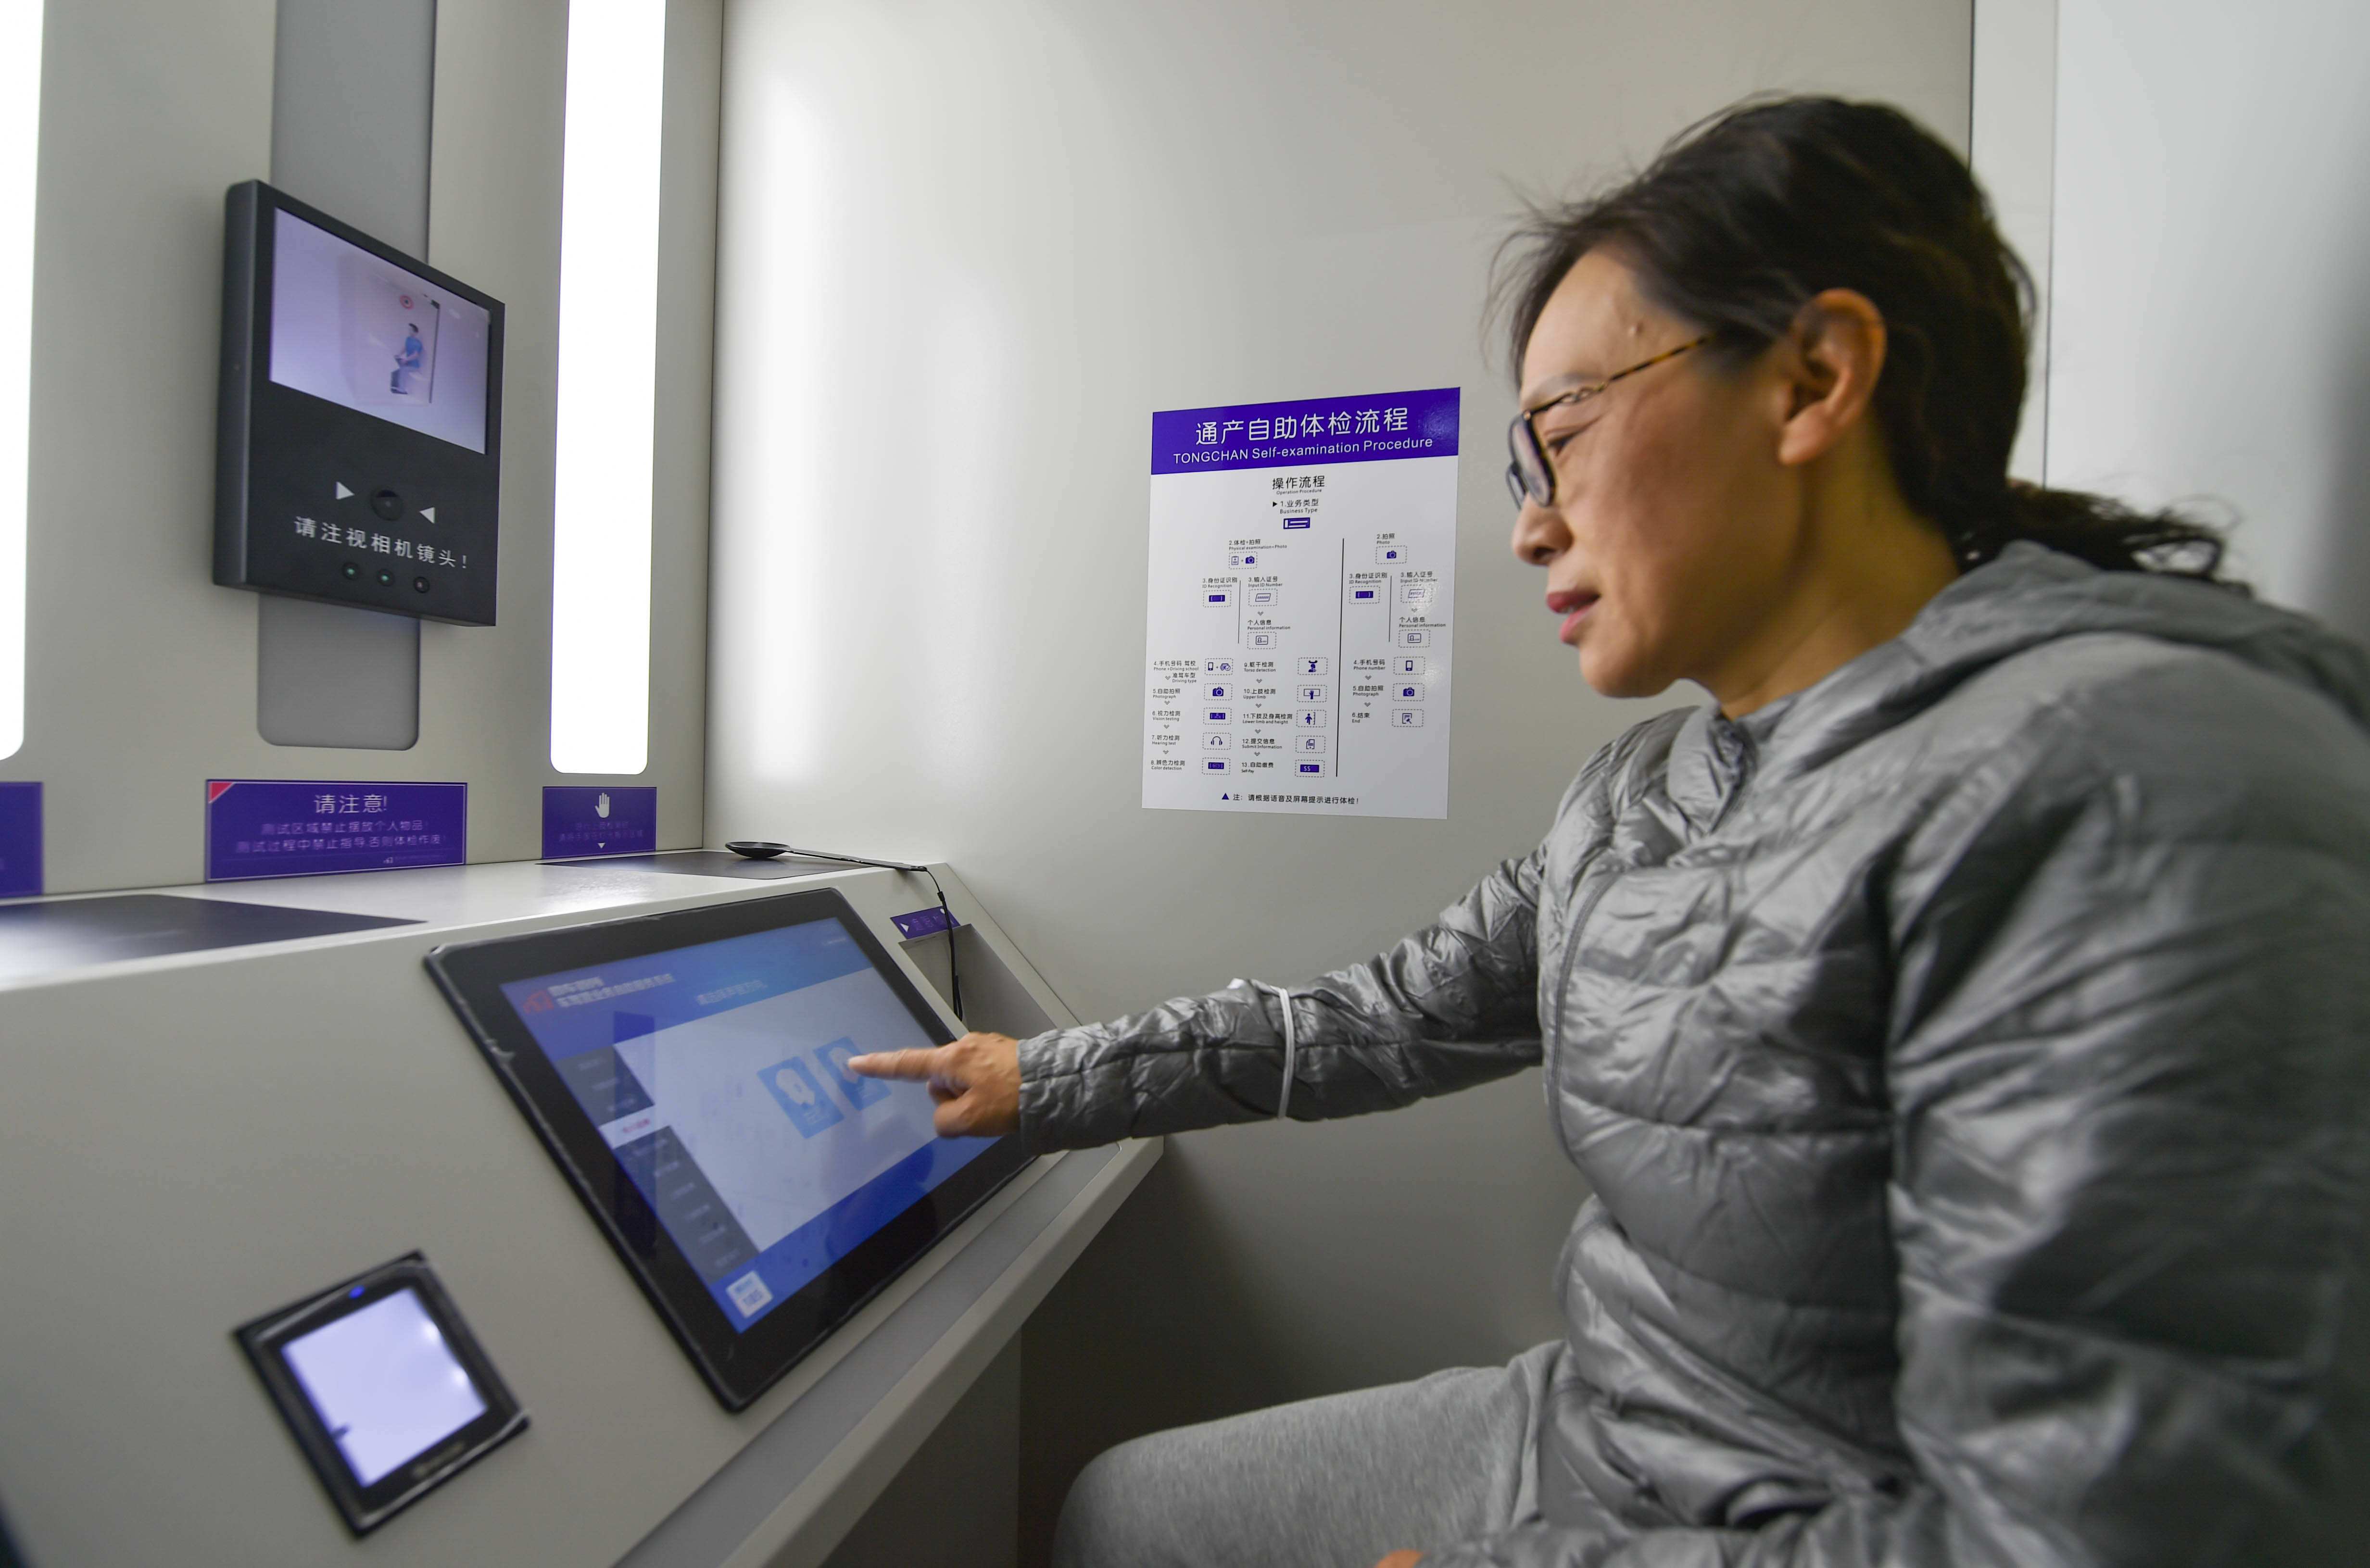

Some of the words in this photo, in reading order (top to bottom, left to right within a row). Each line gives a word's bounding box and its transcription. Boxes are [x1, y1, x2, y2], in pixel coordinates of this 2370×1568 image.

[1196, 407, 1408, 445] 通产自助体检流程
[1173, 449, 1248, 464] TONGCHAN
[1252, 442, 1360, 459] Self-examination
[1363, 438, 1433, 452] Procedure
[1272, 475, 1325, 489] 操作流程
[1280, 498, 1319, 507] 1.业务类型
[294, 516, 467, 569] 请注视相机镜头!
[314, 793, 388, 814] 请注意!
